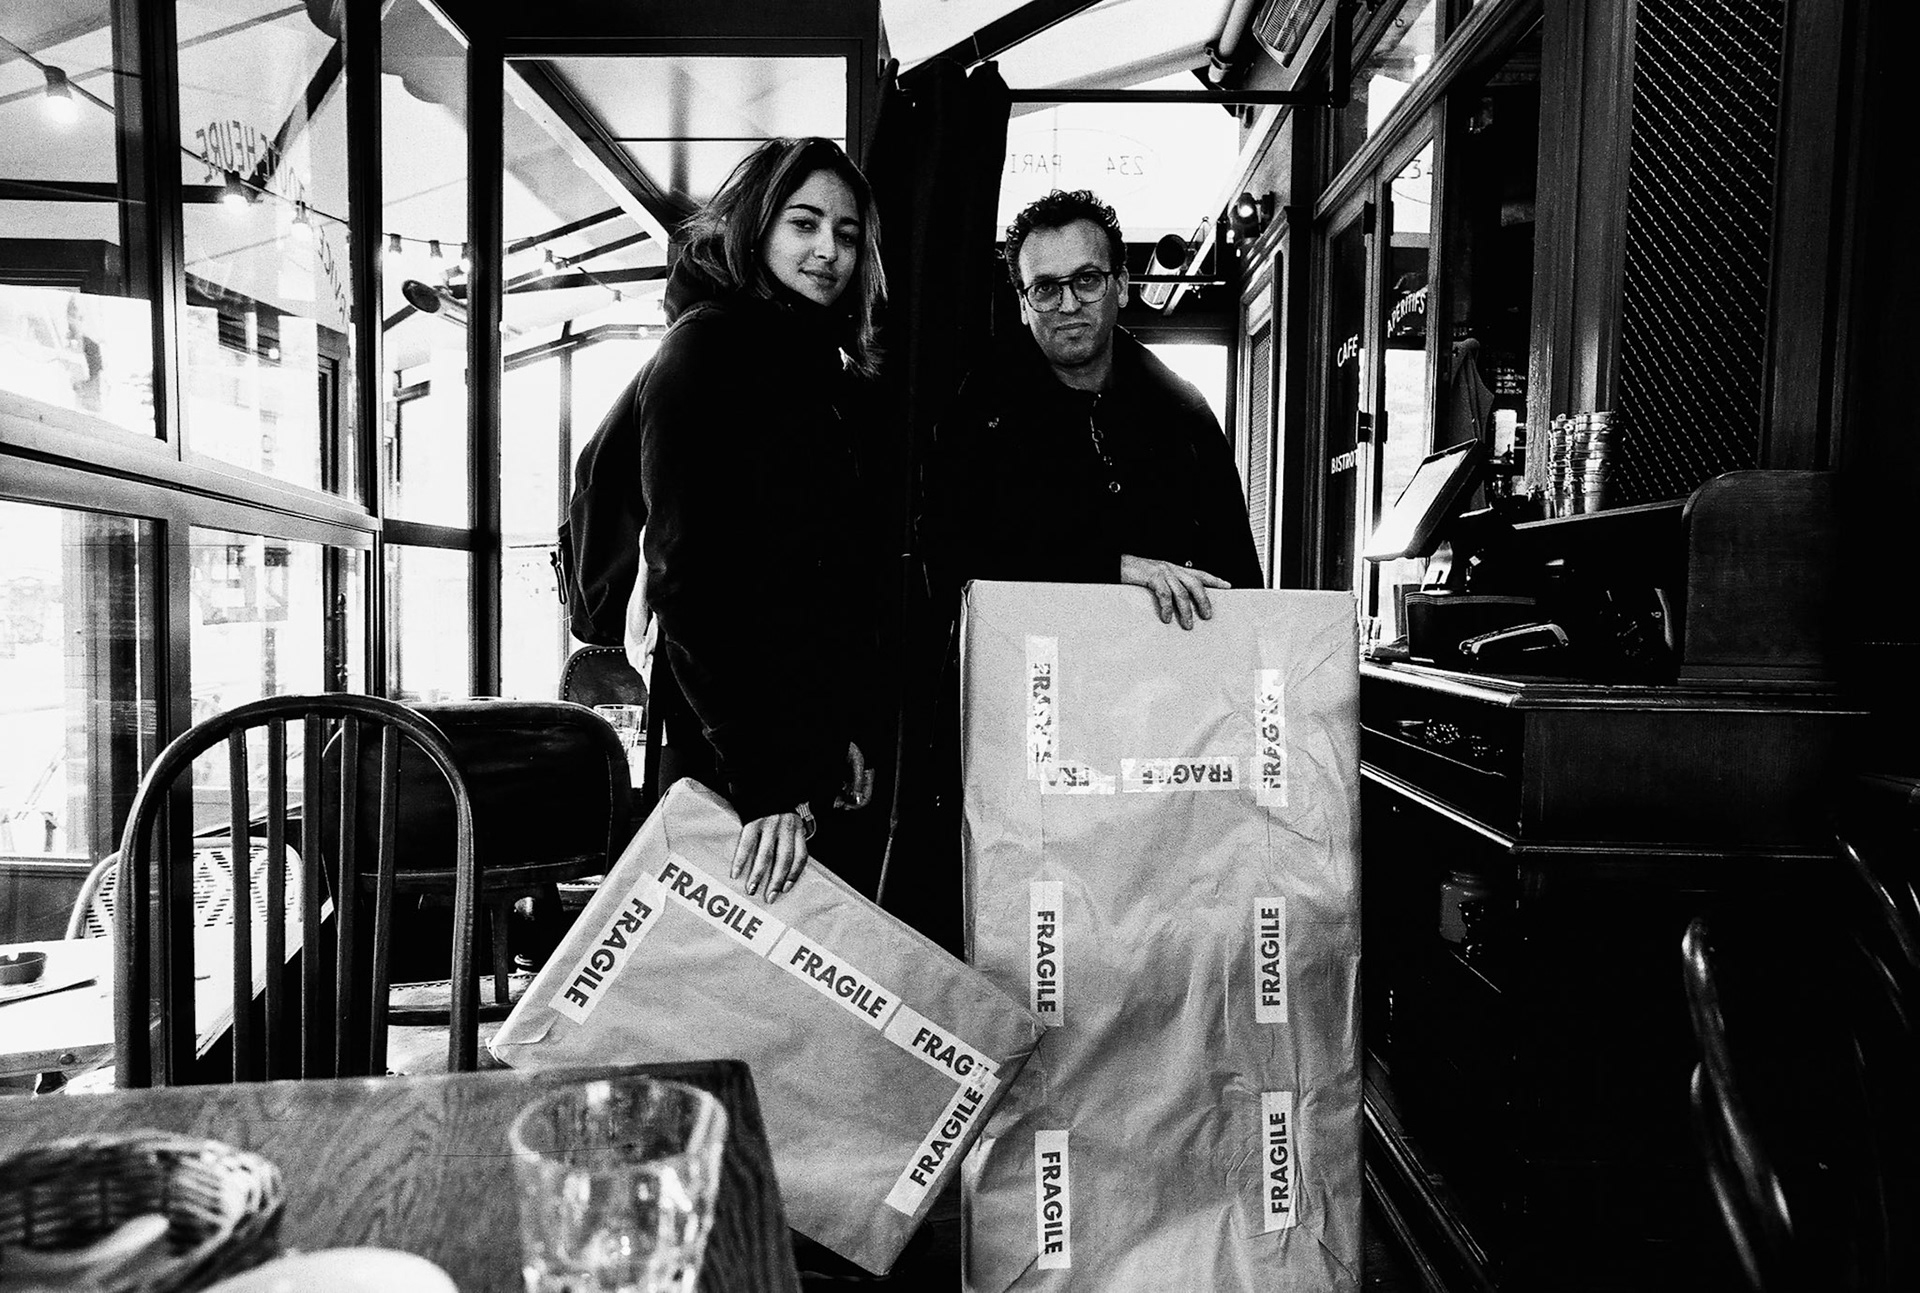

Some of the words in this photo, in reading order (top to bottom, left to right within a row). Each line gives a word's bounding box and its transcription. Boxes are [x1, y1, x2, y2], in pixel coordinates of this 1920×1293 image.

[657, 862, 763, 940] FRAGILE
[564, 898, 652, 1008] FRAGILE
[789, 945, 887, 1019] FRAGILE
[1037, 911, 1056, 1013] FRAGILE
[1261, 907, 1280, 1006] FRAGILE
[910, 1086, 984, 1187] FRAGILE
[1269, 1112, 1289, 1214] FRAGILE
[1041, 1151, 1063, 1255] FRAGILE
